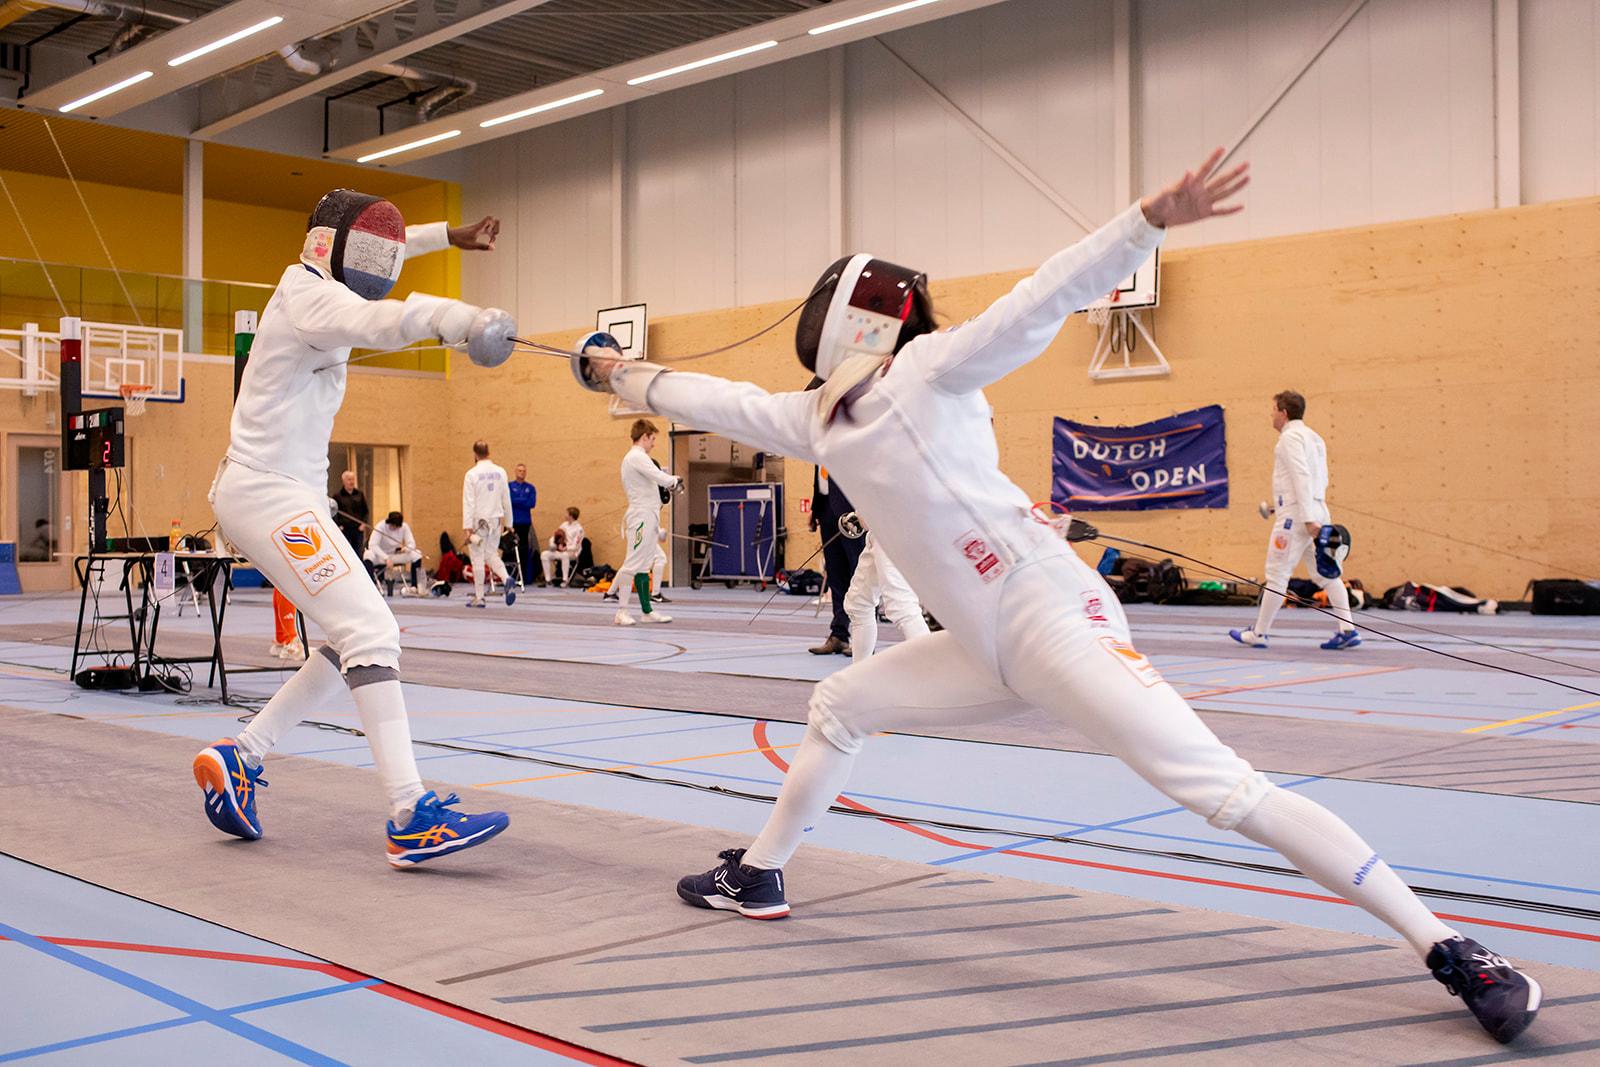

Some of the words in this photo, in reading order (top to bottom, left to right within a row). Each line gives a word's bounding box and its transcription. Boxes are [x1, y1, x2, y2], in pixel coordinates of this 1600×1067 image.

[103, 441, 110, 462] 2
[1073, 438, 1166, 460] DUTCH
[1131, 464, 1206, 491] OPEN
[161, 559, 167, 577] 4
